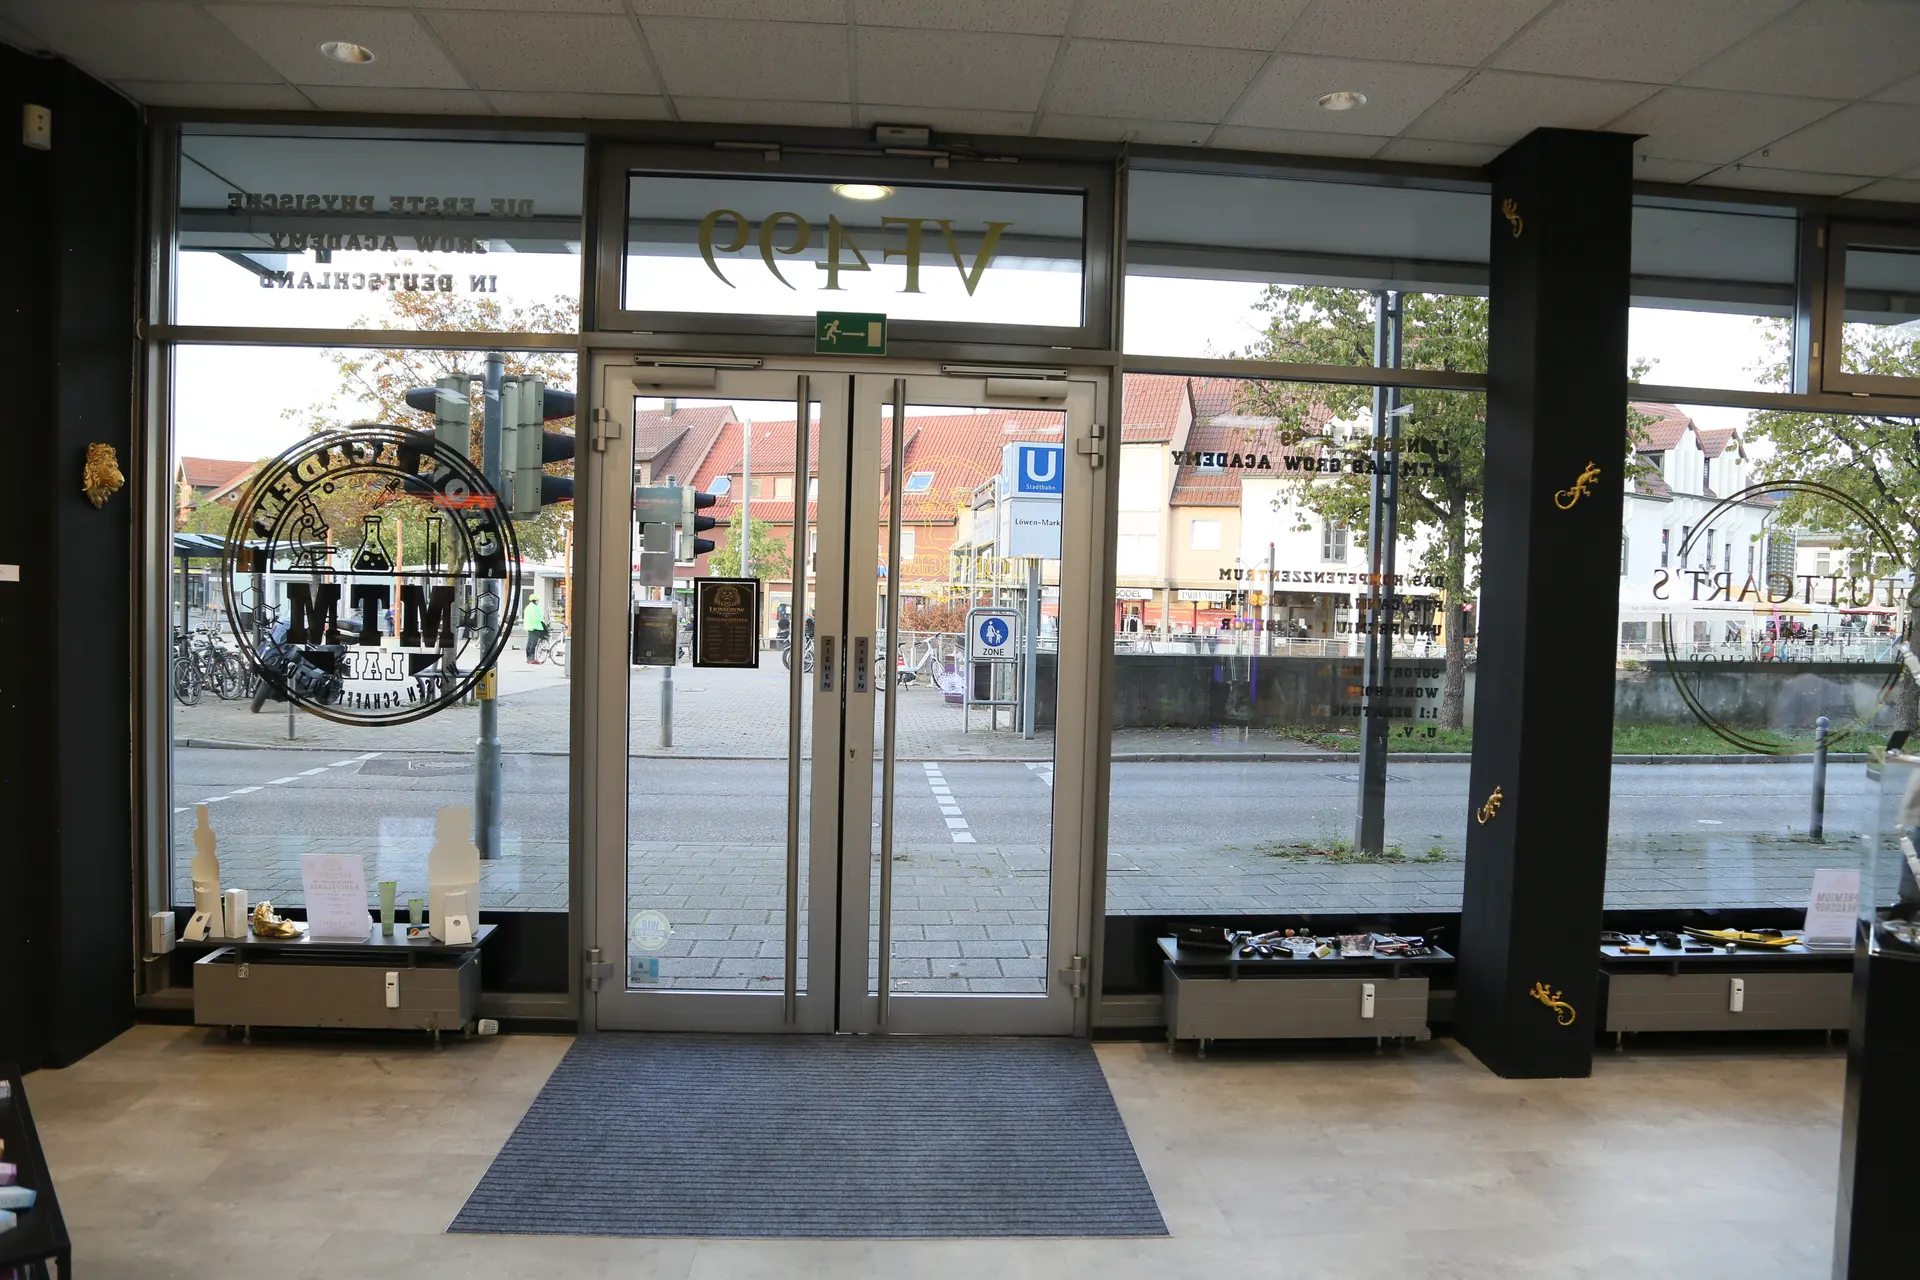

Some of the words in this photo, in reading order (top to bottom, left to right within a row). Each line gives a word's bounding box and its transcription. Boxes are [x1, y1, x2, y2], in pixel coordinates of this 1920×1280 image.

[1027, 450, 1057, 482] U
[1025, 483, 1056, 491] Stadtbahn
[823, 639, 832, 689] ZIEHEN
[857, 640, 866, 689] ZIEHEN
[982, 647, 1005, 657] ZONE
